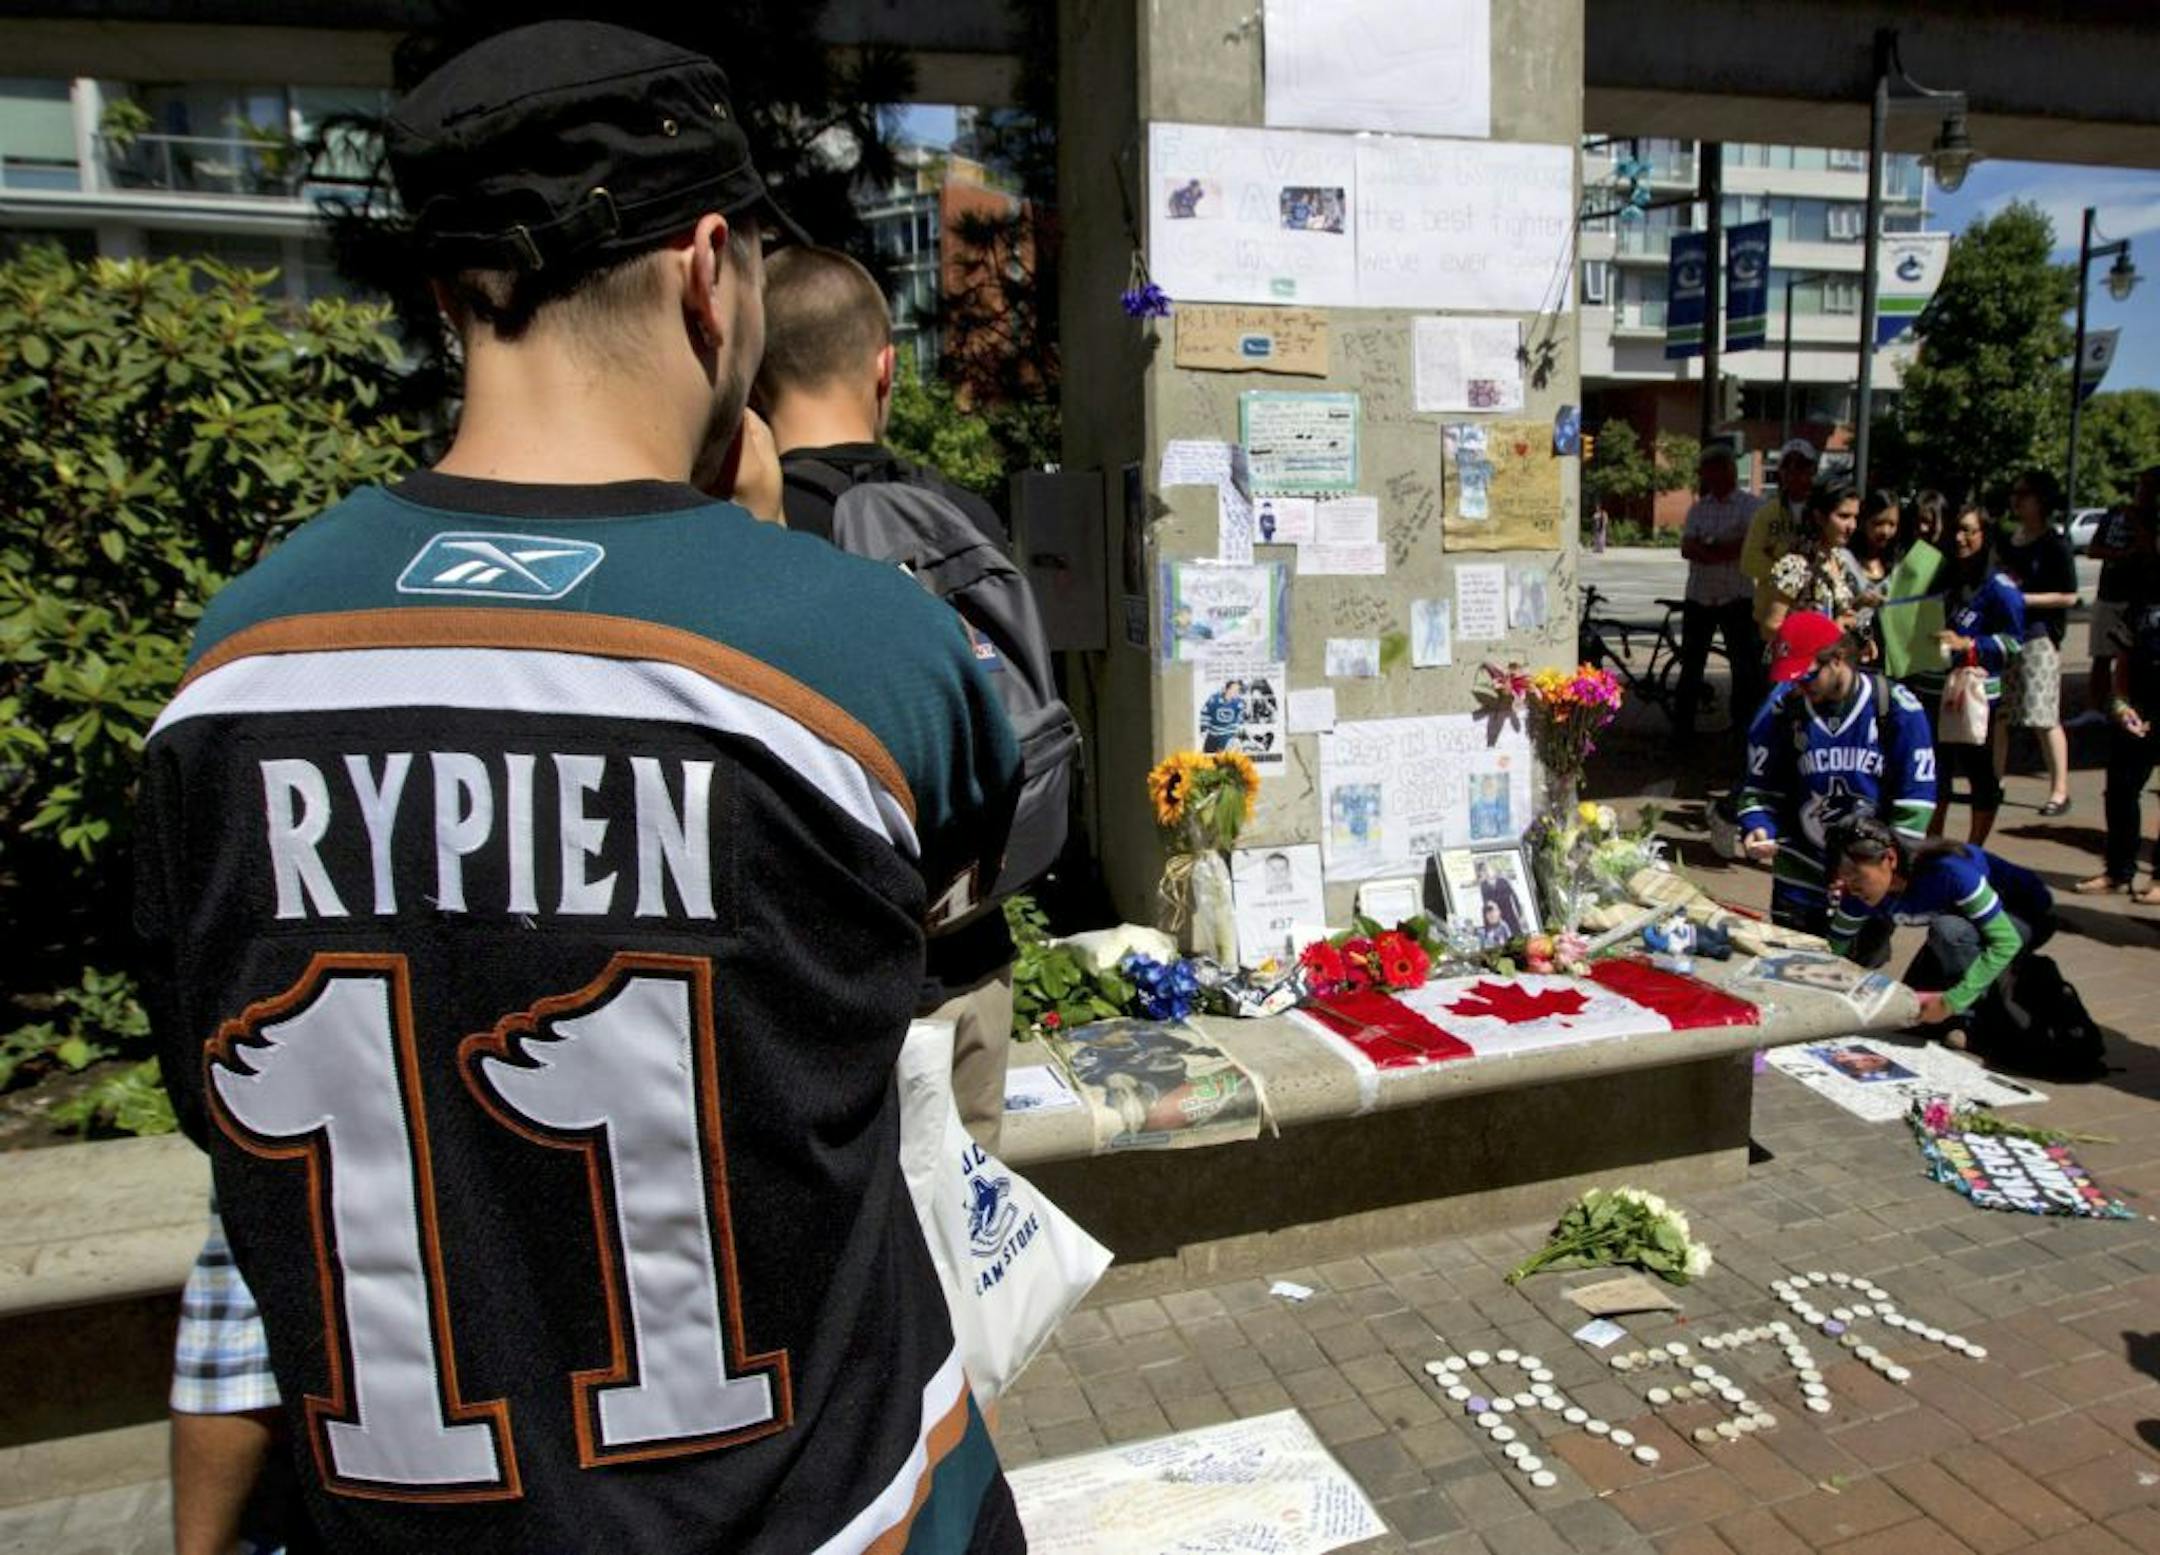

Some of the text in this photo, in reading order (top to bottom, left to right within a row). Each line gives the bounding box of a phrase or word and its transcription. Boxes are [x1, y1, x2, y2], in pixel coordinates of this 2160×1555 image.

[259, 751, 717, 920] RYPIEN
[204, 951, 794, 1503] 11
[1002, 1211, 1041, 1265] STORE
